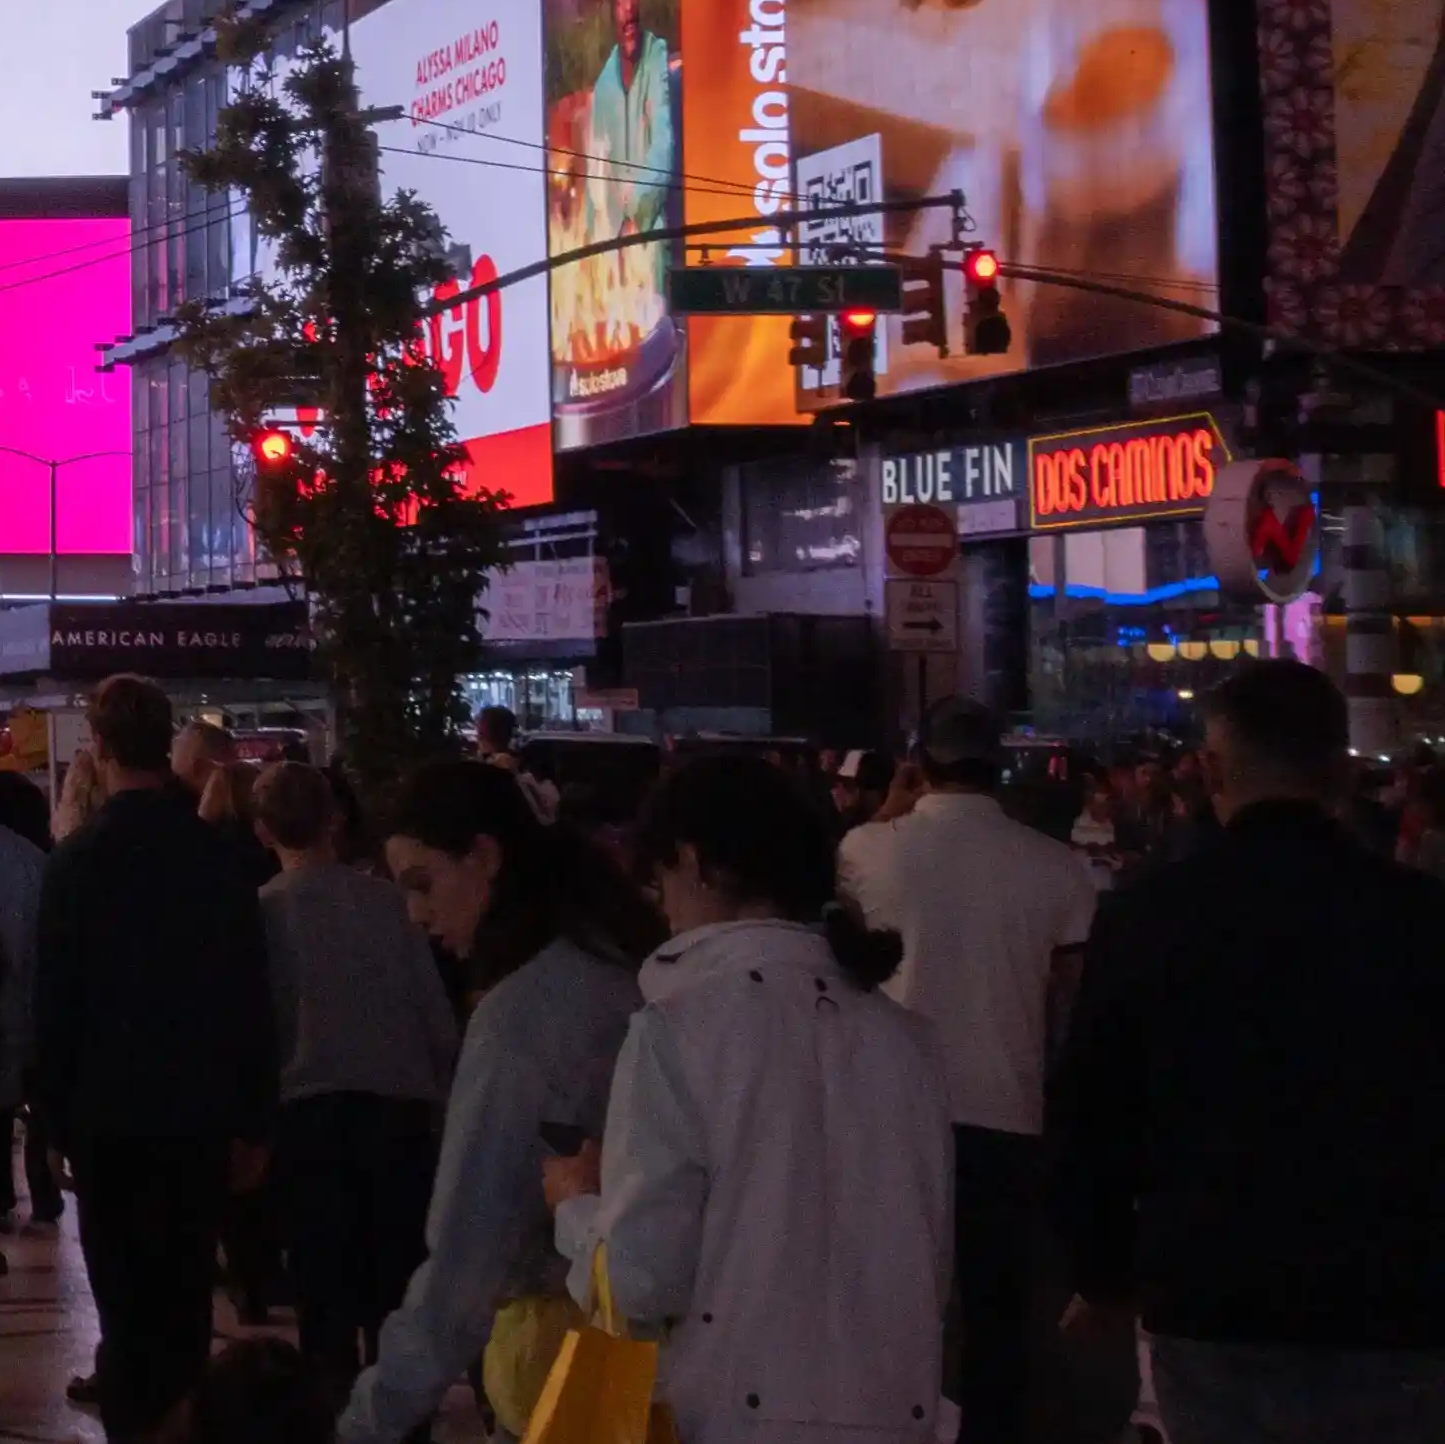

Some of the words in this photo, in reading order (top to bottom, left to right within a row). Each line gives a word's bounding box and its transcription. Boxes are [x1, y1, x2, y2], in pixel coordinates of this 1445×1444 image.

[416, 44, 453, 86] ALYSSA
[454, 19, 499, 67] MILANO
[411, 82, 453, 128] CHARMS
[456, 56, 506, 105] CHICAGO
[723, 276, 750, 304] W
[768, 275, 796, 302] 47
[817, 273, 845, 302] St
[882, 452, 953, 504] BLUE
[965, 442, 1013, 497] FIN
[1035, 448, 1087, 515] DOS
[1090, 427, 1215, 508] CAMINOS
[51, 628, 165, 647] AMERICAN
[177, 627, 242, 648] EAGLE
